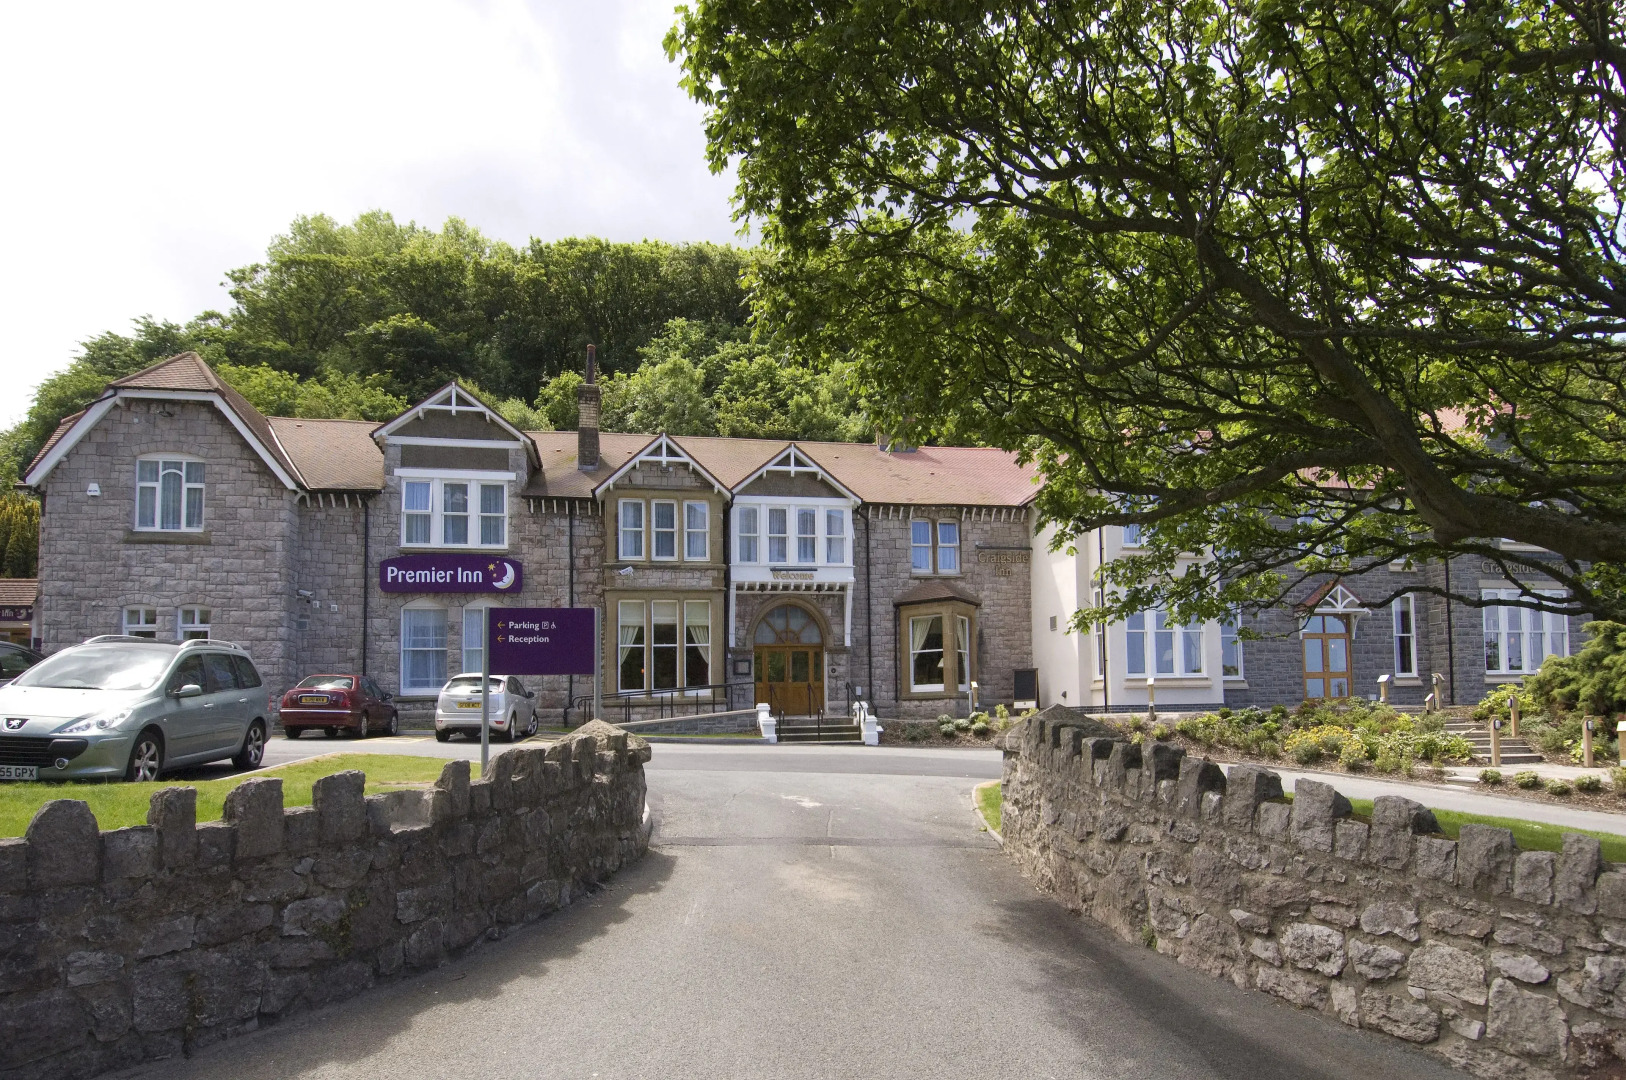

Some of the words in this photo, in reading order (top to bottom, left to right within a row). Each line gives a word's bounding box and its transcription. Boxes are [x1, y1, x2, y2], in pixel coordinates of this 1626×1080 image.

[978, 552, 1029, 565] Craigside
[387, 567, 454, 583] Premier
[457, 567, 483, 583] Inn
[772, 570, 815, 580] Welcome
[995, 565, 1012, 576] Inn
[508, 621, 540, 631] Parking
[508, 635, 550, 644] Reception
[14, 767, 35, 778] GPX
